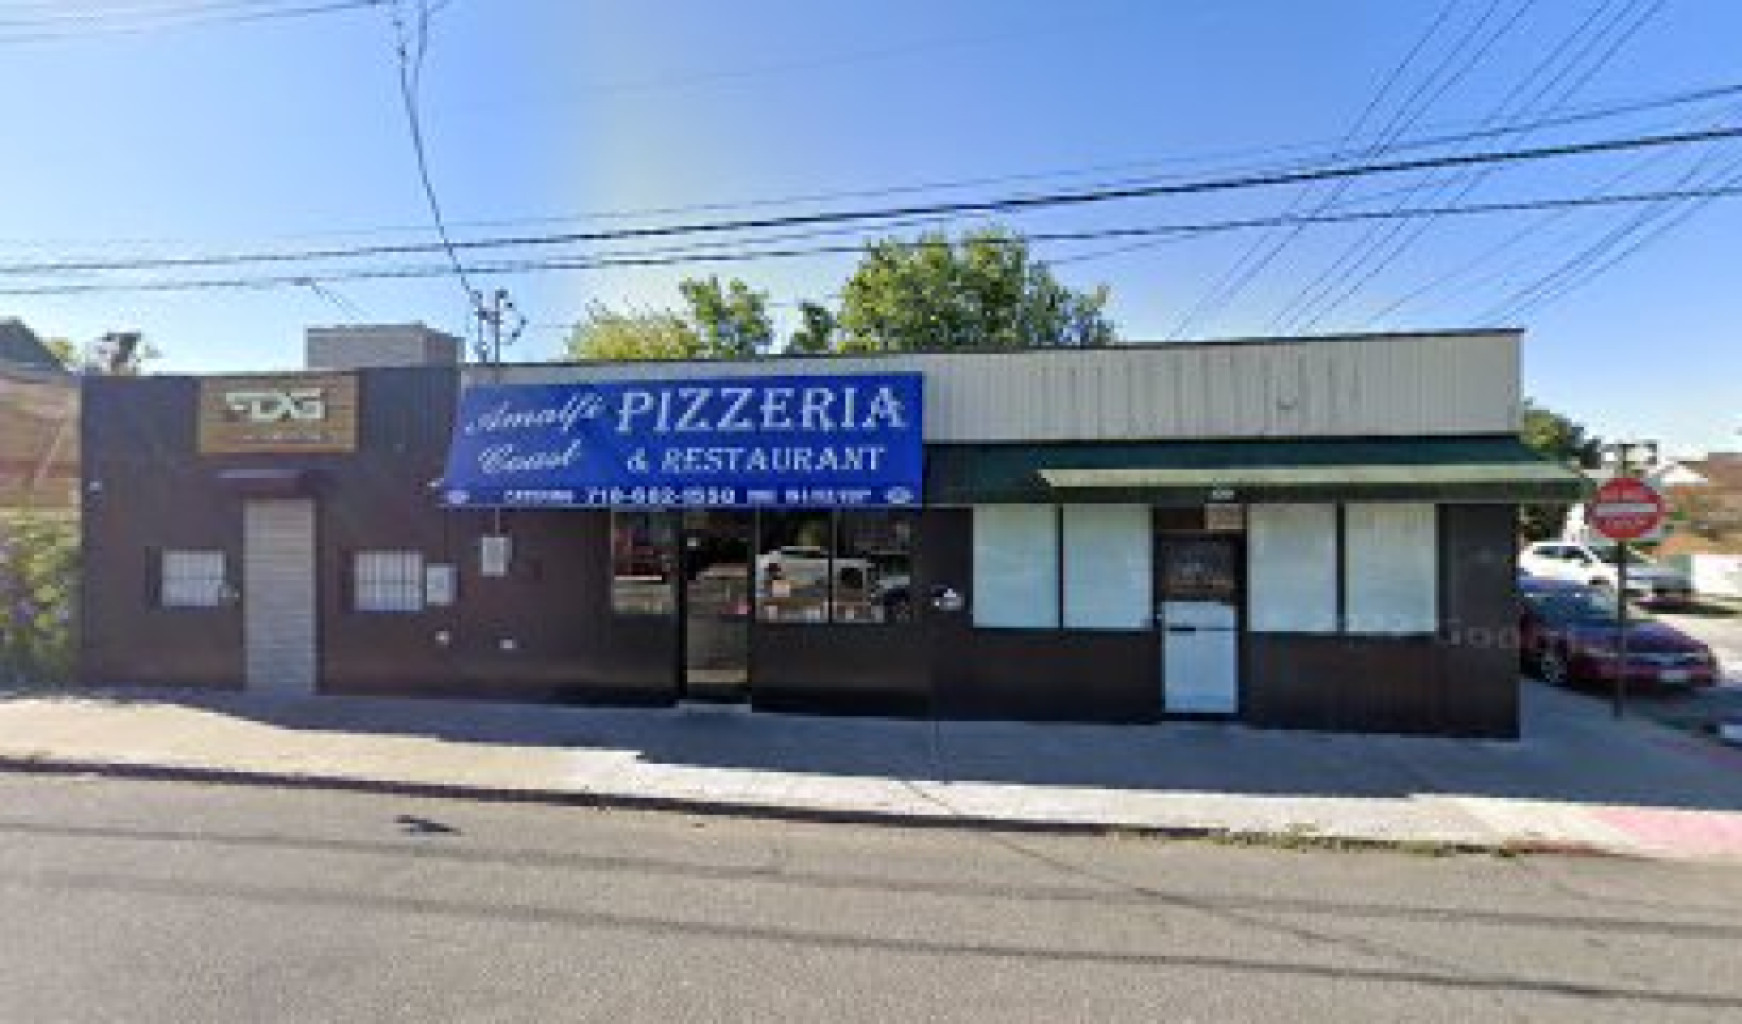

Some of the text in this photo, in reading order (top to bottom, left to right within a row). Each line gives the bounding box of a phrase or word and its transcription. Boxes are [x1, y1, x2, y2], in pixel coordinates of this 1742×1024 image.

[465, 392, 603, 433] Amalfi
[616, 387, 908, 433] PIZZERIA
[477, 438, 581, 474] Coast
[627, 446, 886, 472] & RESTAURANT
